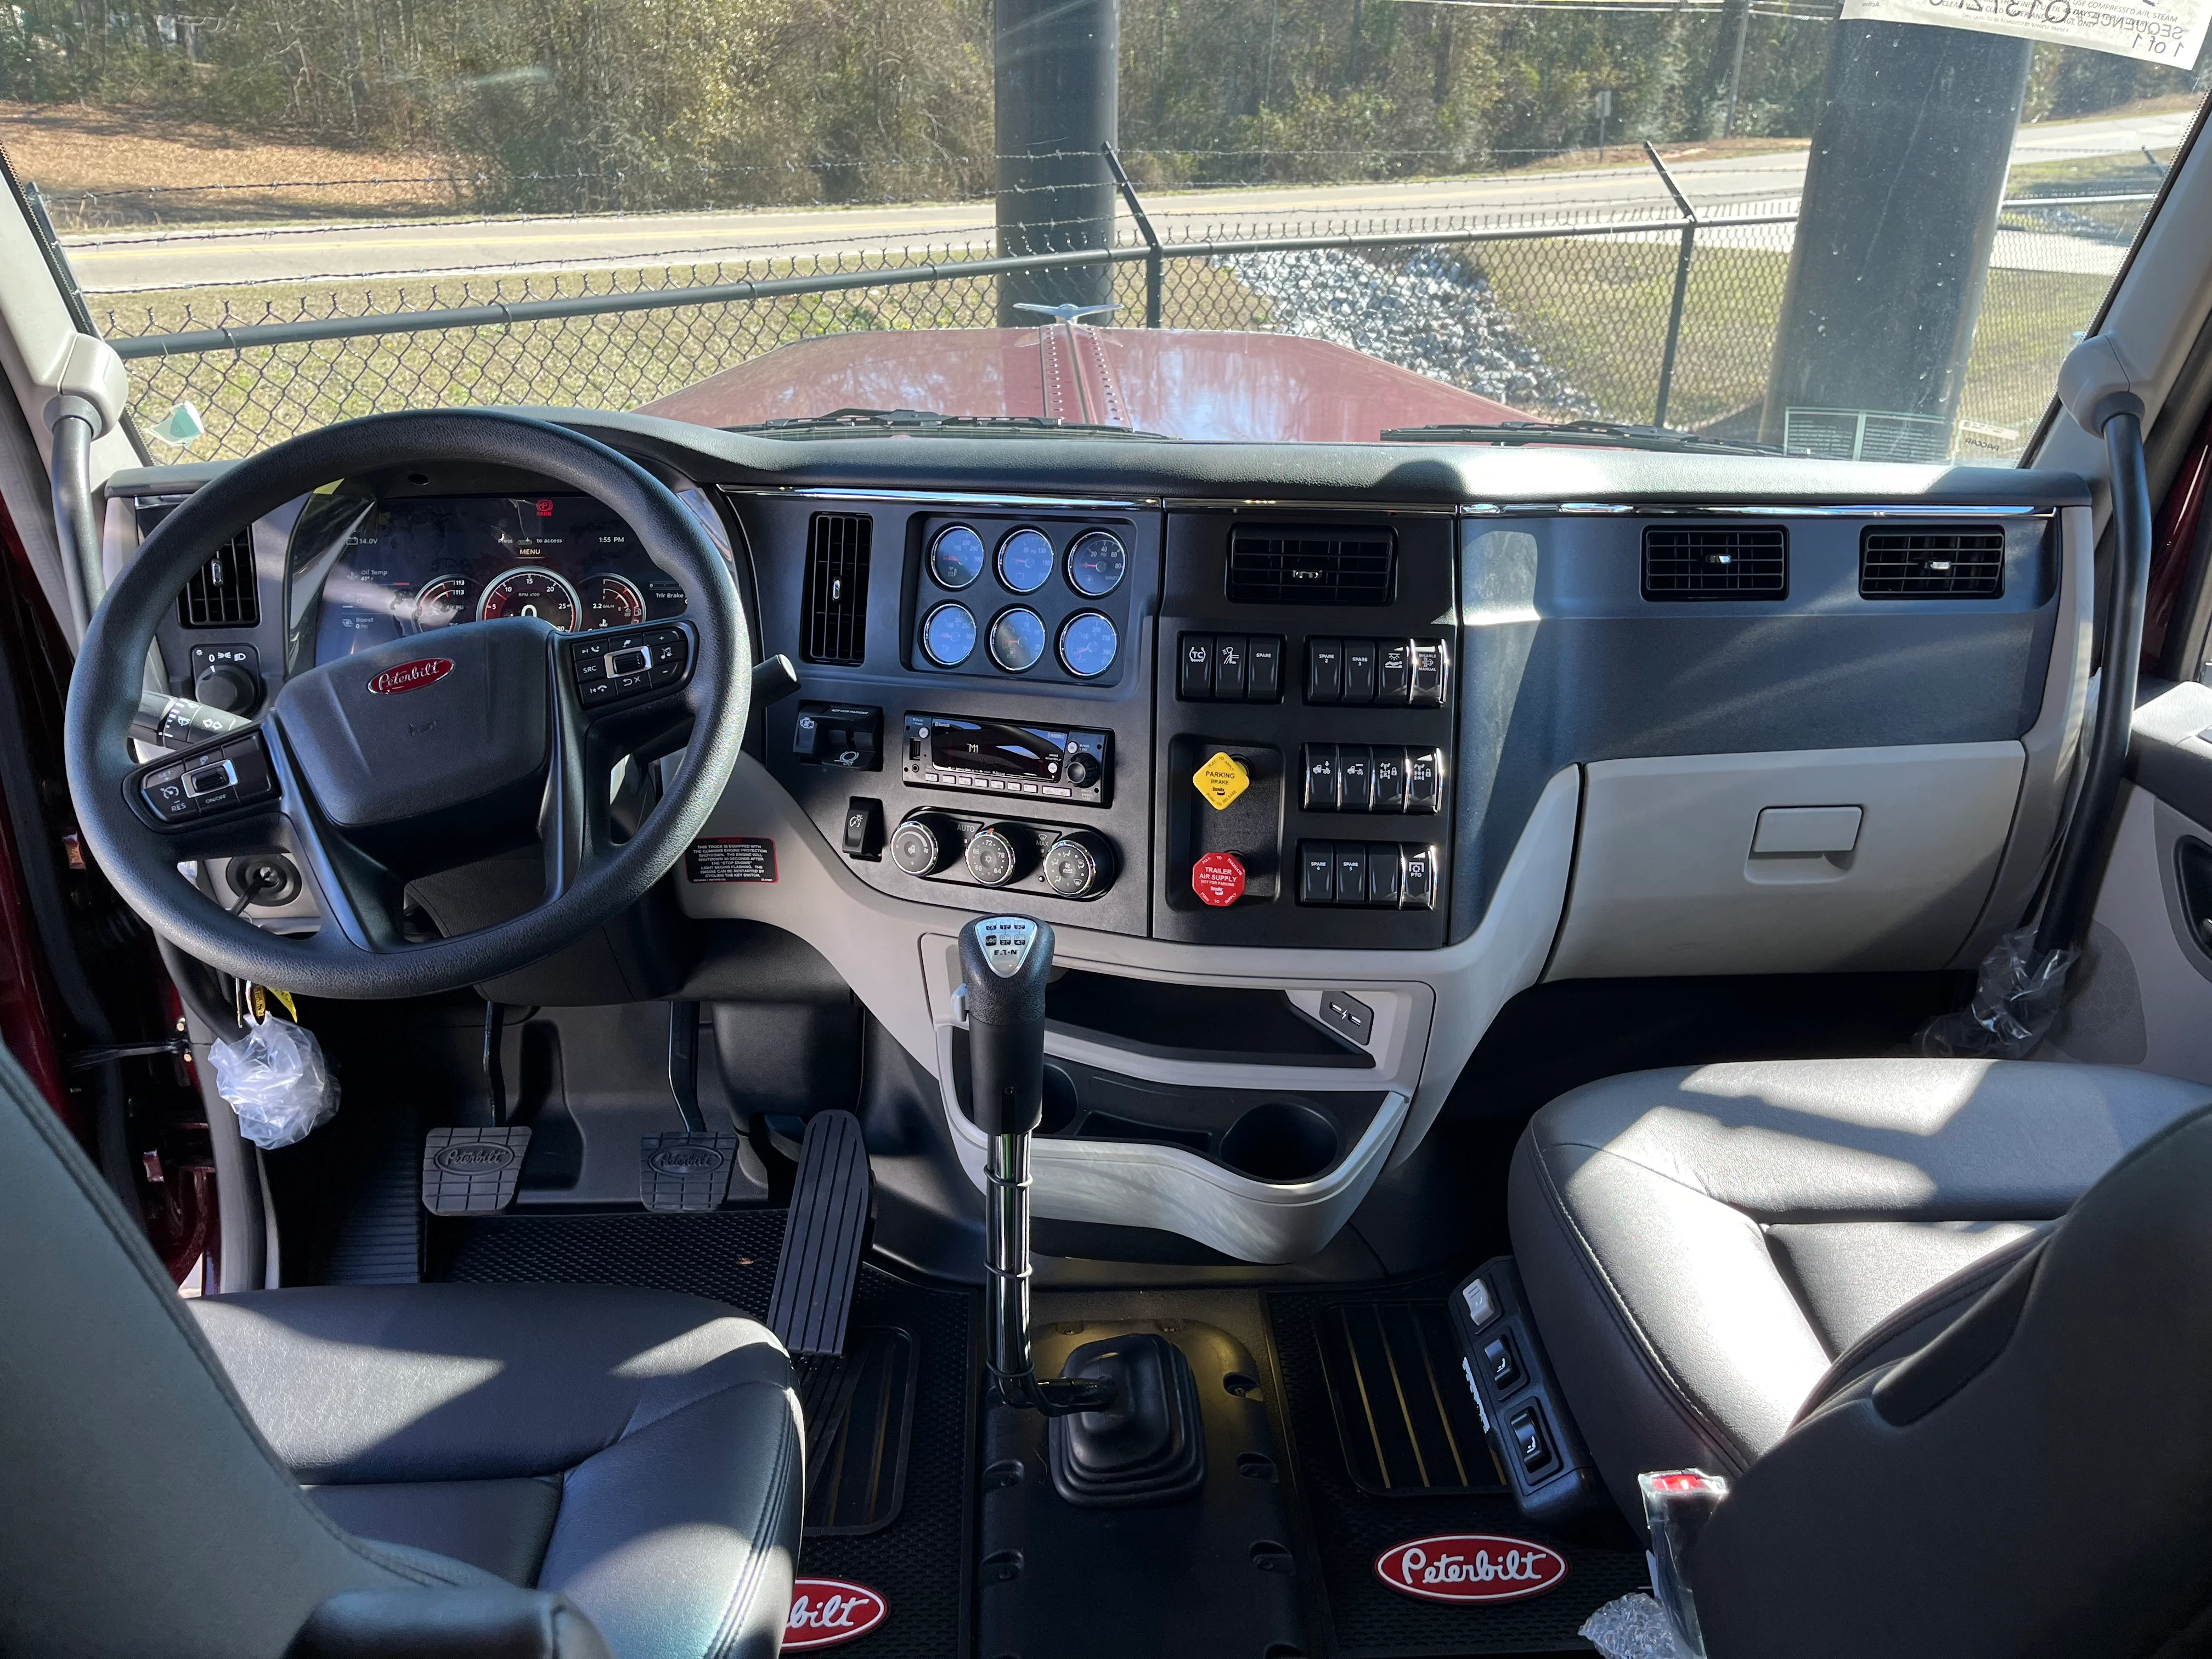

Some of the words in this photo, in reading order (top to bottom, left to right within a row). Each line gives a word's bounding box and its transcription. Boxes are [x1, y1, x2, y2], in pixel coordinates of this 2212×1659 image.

[2073, 9, 2091, 18] DAYS
[2088, 1, 2135, 15] COMPRESSED
[2153, 13, 2178, 22] STEAM
[2077, 20, 2096, 28] ONLY
[583, 665, 597, 674] SRC
[379, 660, 444, 691] Peterbilt
[969, 744, 979, 753] M1
[1224, 761, 1234, 771] APPLY
[1205, 771, 1235, 779] PARKING
[205, 794, 227, 804] ON/OFF
[1222, 790, 1237, 803] RELEASE
[171, 803, 187, 812] RES
[1205, 867, 1232, 875] TRAILER
[1227, 858, 1243, 876] EVACUATE
[1211, 874, 1237, 882] SUPPLY
[445, 1149, 507, 1166] Peterbilt
[1402, 1548, 1547, 1584] Peterbilt
[786, 1594, 870, 1629] bilt
